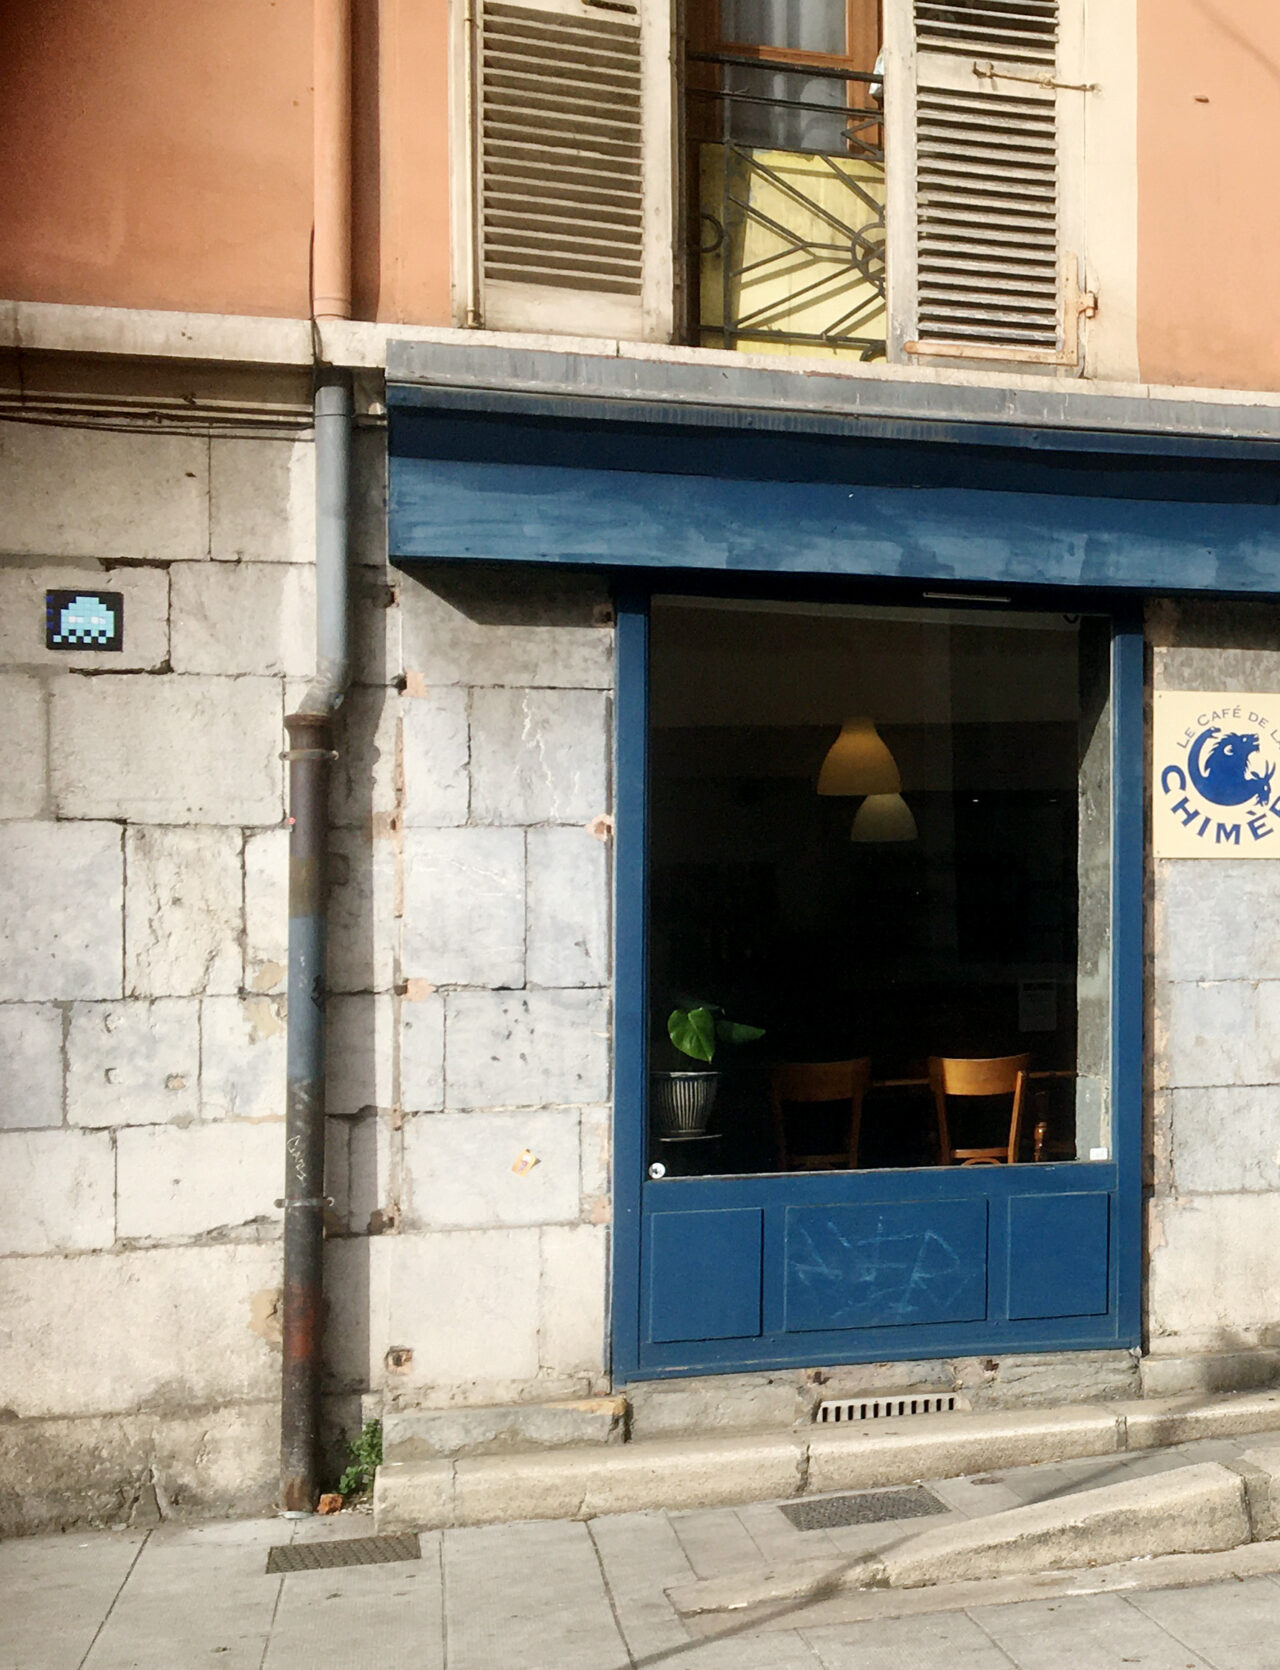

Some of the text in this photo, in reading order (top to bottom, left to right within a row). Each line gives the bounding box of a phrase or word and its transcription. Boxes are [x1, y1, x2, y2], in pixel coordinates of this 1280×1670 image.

[1176, 728, 1196, 750] LE
[1197, 705, 1242, 726] CAFÉ
[1248, 711, 1269, 729] DE
